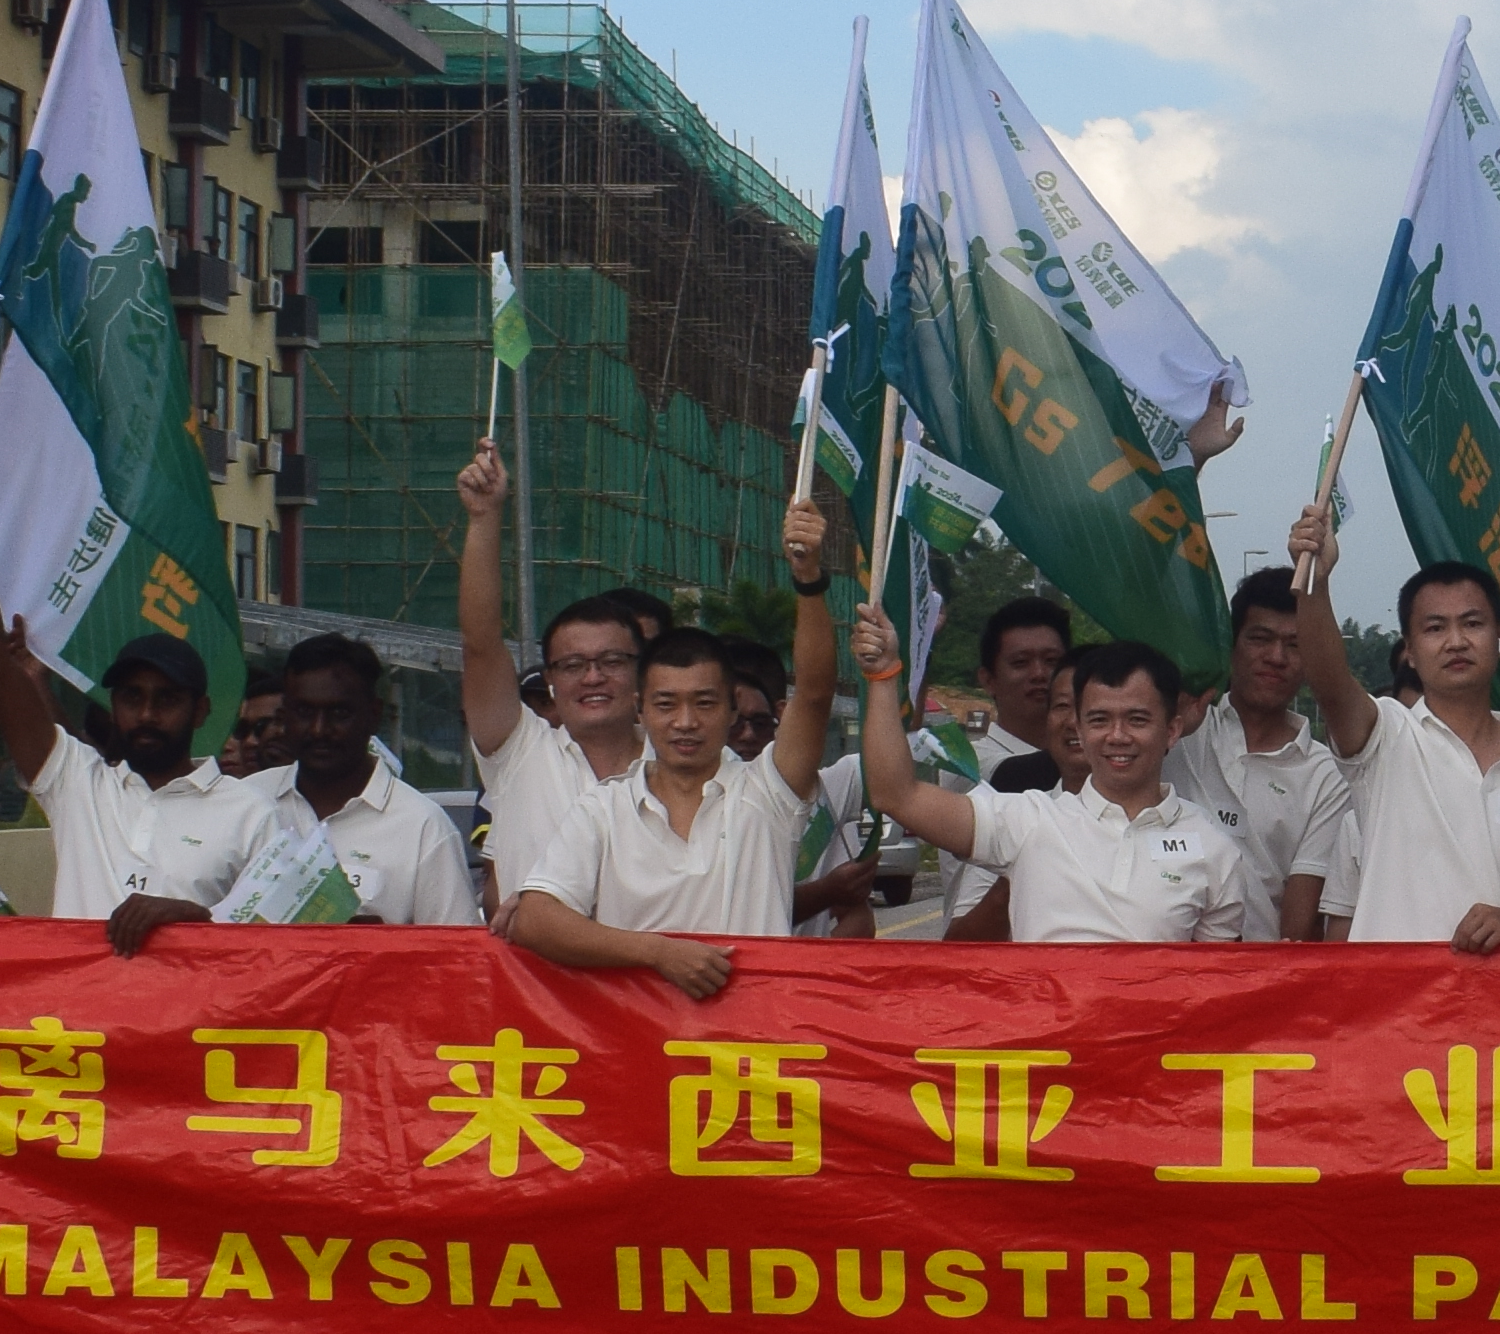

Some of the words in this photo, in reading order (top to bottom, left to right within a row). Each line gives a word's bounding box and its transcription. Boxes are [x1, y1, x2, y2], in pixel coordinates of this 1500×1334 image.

[1086, 435, 1212, 572] Tea
[1162, 838, 1188, 853] M1
[125, 872, 148, 891] A1
[616, 1246, 1358, 1323] INDUSTRIAL
